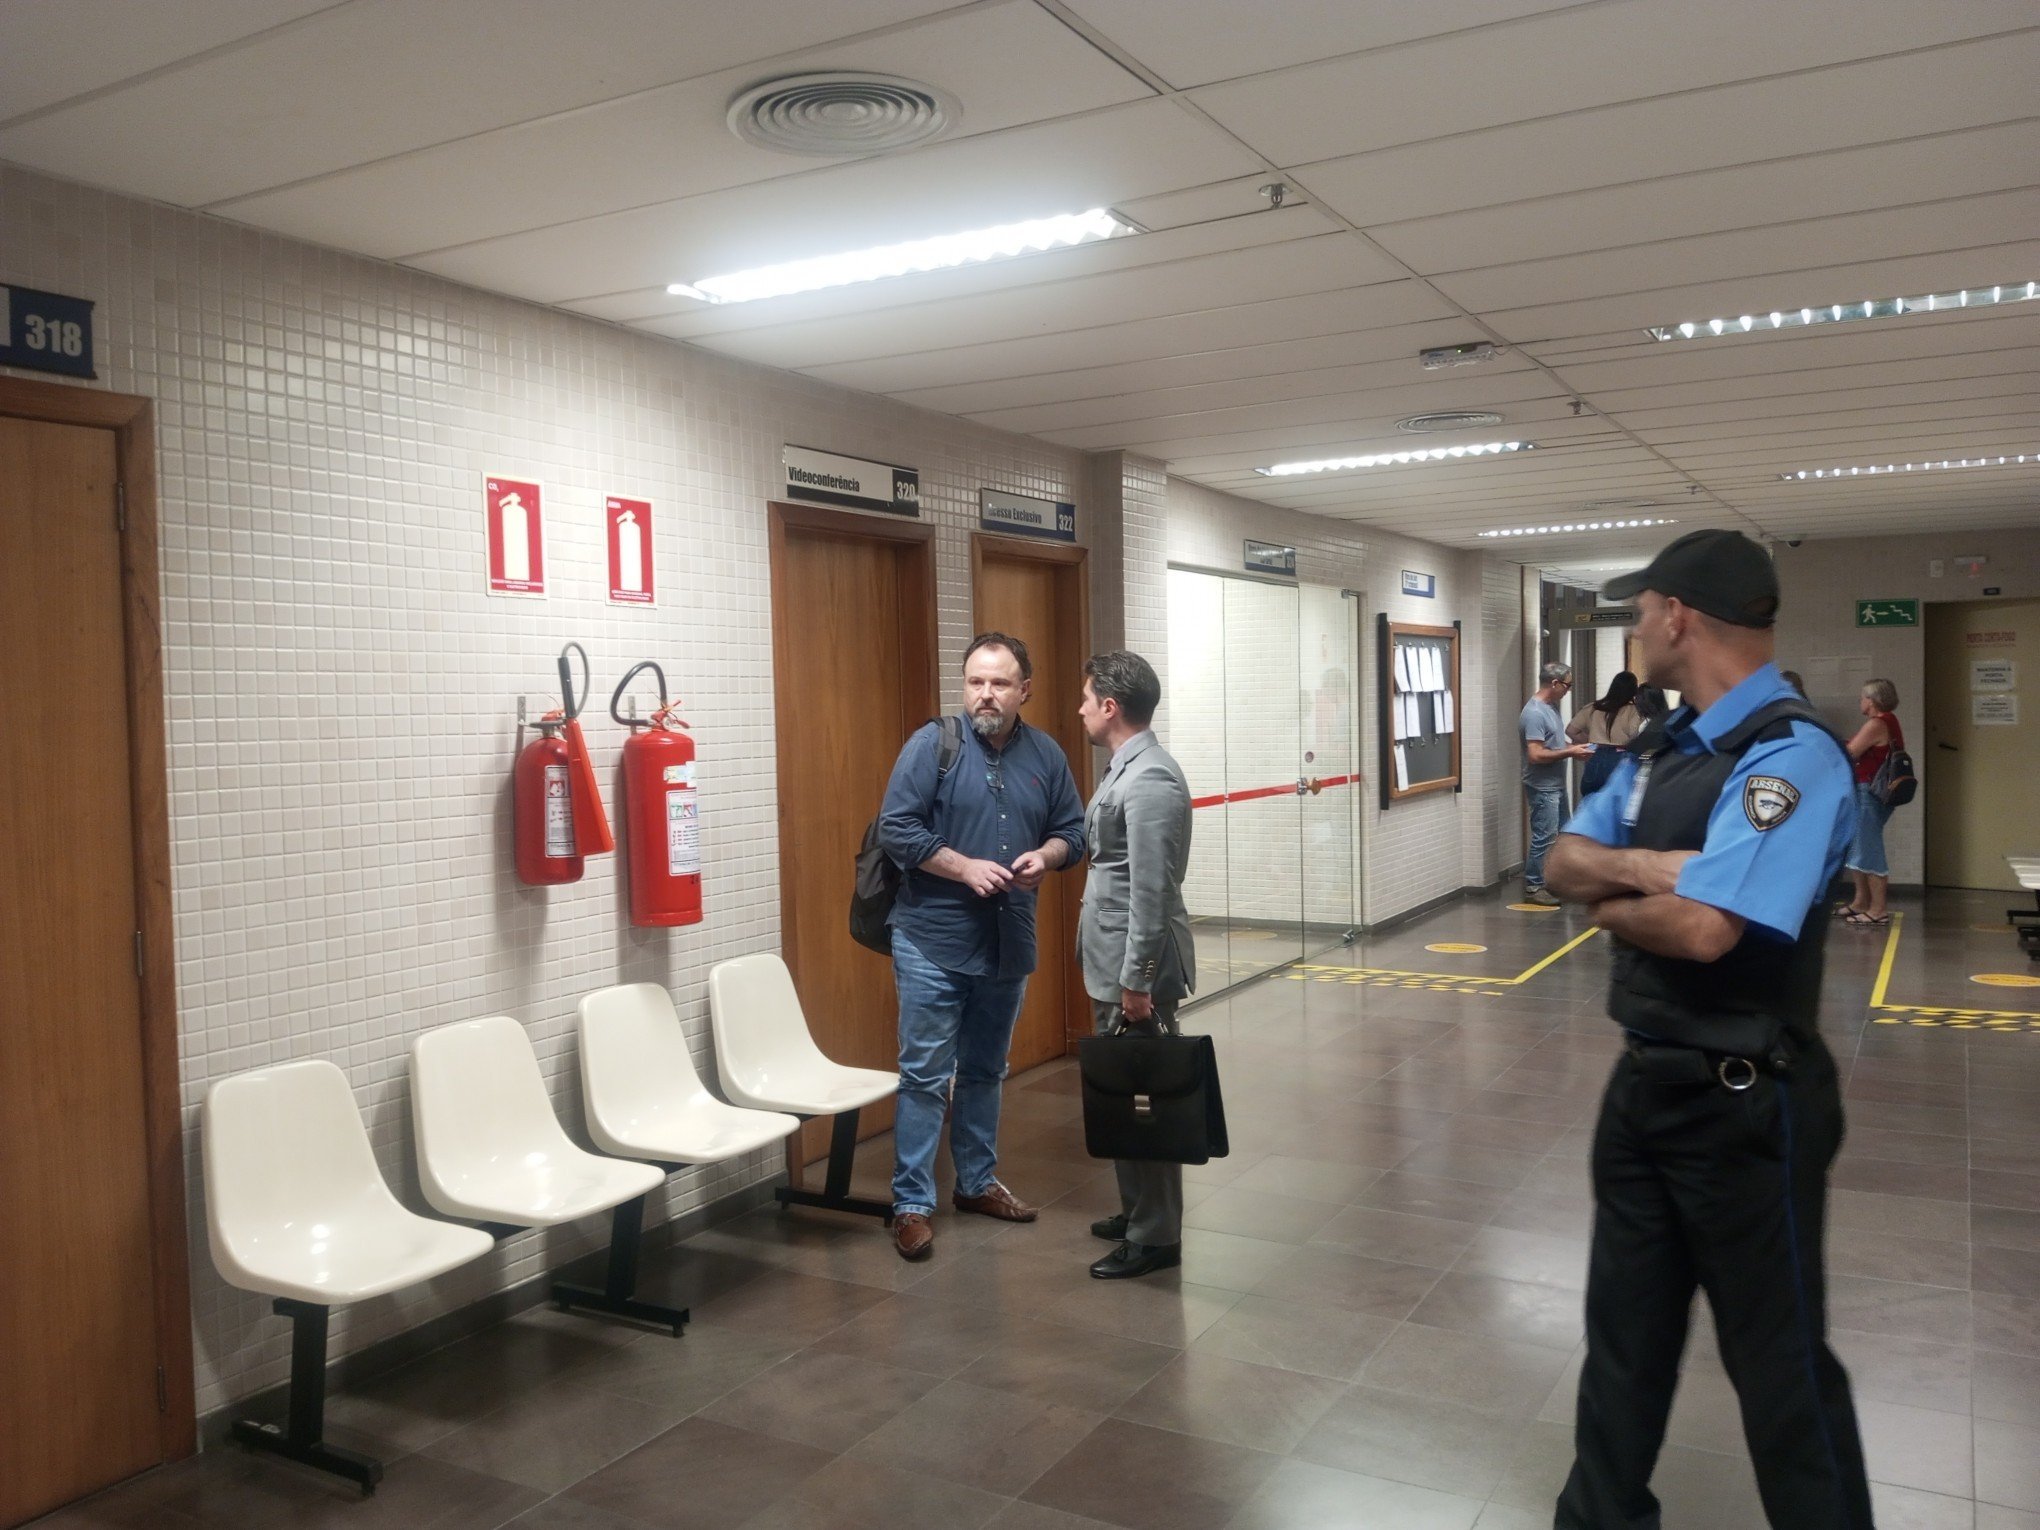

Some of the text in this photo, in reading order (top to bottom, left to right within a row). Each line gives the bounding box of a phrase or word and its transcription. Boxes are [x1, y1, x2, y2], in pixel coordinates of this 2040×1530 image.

[25, 314, 83, 356] 318
[788, 466, 917, 502] Videoconferência 320
[1013, 508, 1042, 524] Exclusivo
[1058, 514, 1073, 532] 322
